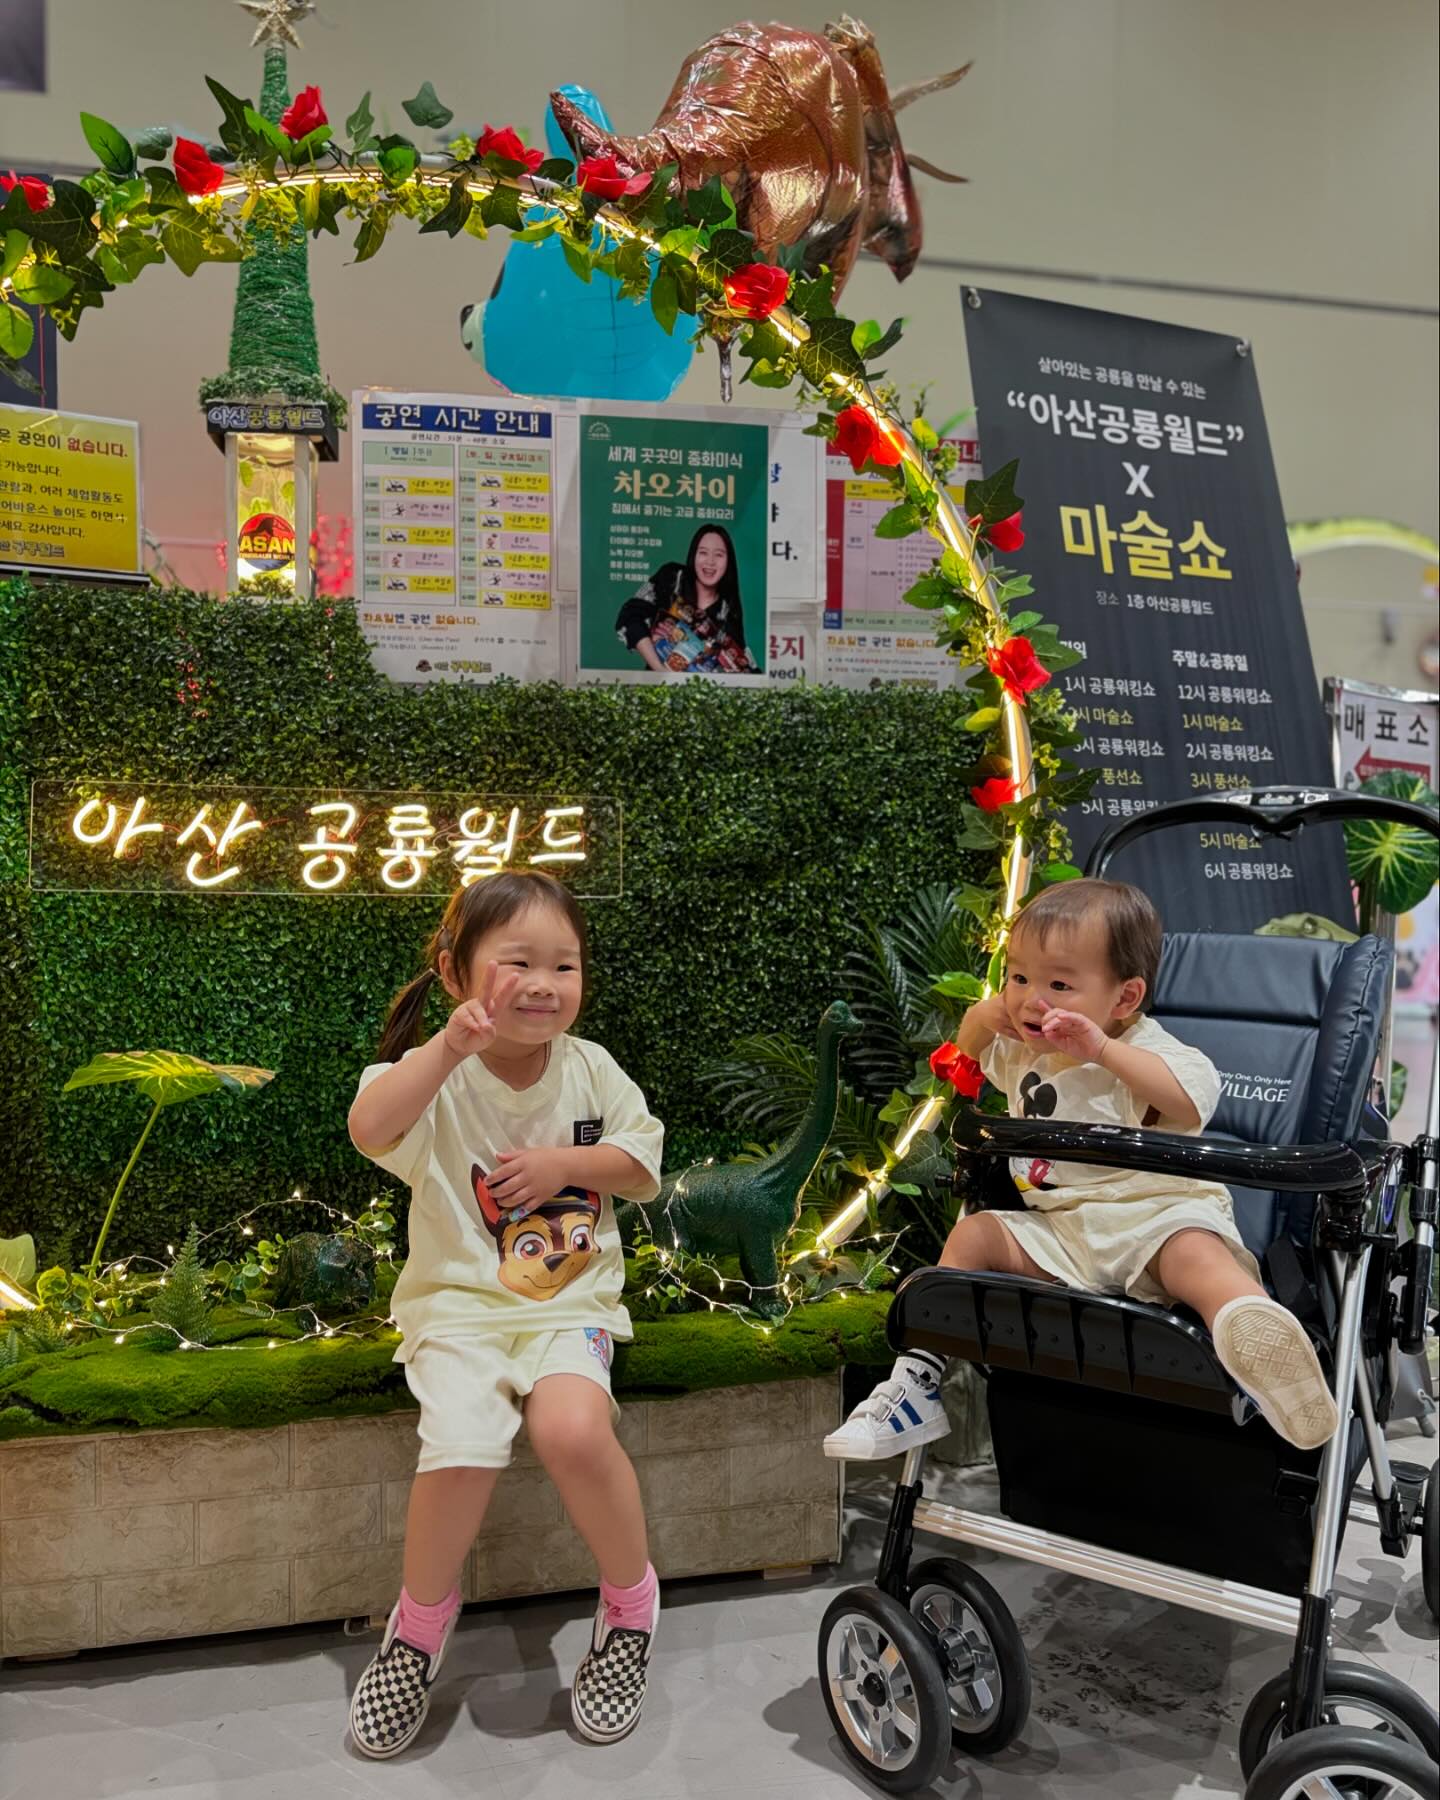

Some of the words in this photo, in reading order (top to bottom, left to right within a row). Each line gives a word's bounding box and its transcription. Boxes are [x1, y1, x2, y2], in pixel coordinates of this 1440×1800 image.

[1038, 357, 1092, 381] 살아있는
[1095, 366, 1134, 388] 공룡을
[1136, 373, 1163, 393] 만날
[1166, 379, 1178, 395] 수
[1181, 380, 1206, 400] 있는
[376, 404, 421, 428] 공연
[434, 408, 481, 431] 시간
[494, 411, 540, 434] 안내
[17, 430, 61, 449] 공연이
[67, 437, 128, 458] 없습니다.
[608, 445, 637, 463] 세계
[641, 447, 683, 465] 곳곳의
[688, 450, 743, 469] 중화미식
[5, 459, 62, 477] 가능합니다.
[40, 485, 63, 497] 여러
[67, 487, 124, 504] 체험활동도
[613, 469, 735, 505] 차오차이
[53, 505, 88, 519] 놀이도
[0, 521, 25, 534] 세요.
[28, 523, 86, 538] 감사합니다.
[239, 535, 295, 553] ASAN
[1059, 504, 1233, 581] 마술쇼
[1096, 591, 1119, 606] 장소
[1127, 594, 1145, 610] 1층
[1147, 596, 1215, 616] 아산공룡월드
[1172, 650, 1249, 672] 주말&공휴일
[1065, 676, 1086, 693] 1시
[1089, 677, 1157, 697] 공룡워킹쇼
[1178, 685, 1206, 701] 12시
[1208, 685, 1273, 704] 공룡워킹쇼
[1093, 708, 1134, 726] 마술쇼
[1183, 714, 1203, 730] 1시
[1204, 715, 1244, 732] 마술쇼
[1344, 704, 1429, 746] 매표소
[1098, 738, 1166, 757] 공룡워킹쇼
[1186, 743, 1207, 760] 2시
[1209, 743, 1275, 761] 공룡워킹쇼
[1103, 767, 1144, 785] 풍선쇼
[1191, 773, 1212, 789] 3시
[1214, 773, 1252, 789] 풍선쇼
[1200, 832, 1221, 849] 5시
[1204, 862, 1226, 879] 6시
[1228, 863, 1294, 881] 공룡워킹쇼
[1254, 1075, 1273, 1085] Only
[1274, 1078, 1292, 1086] Here
